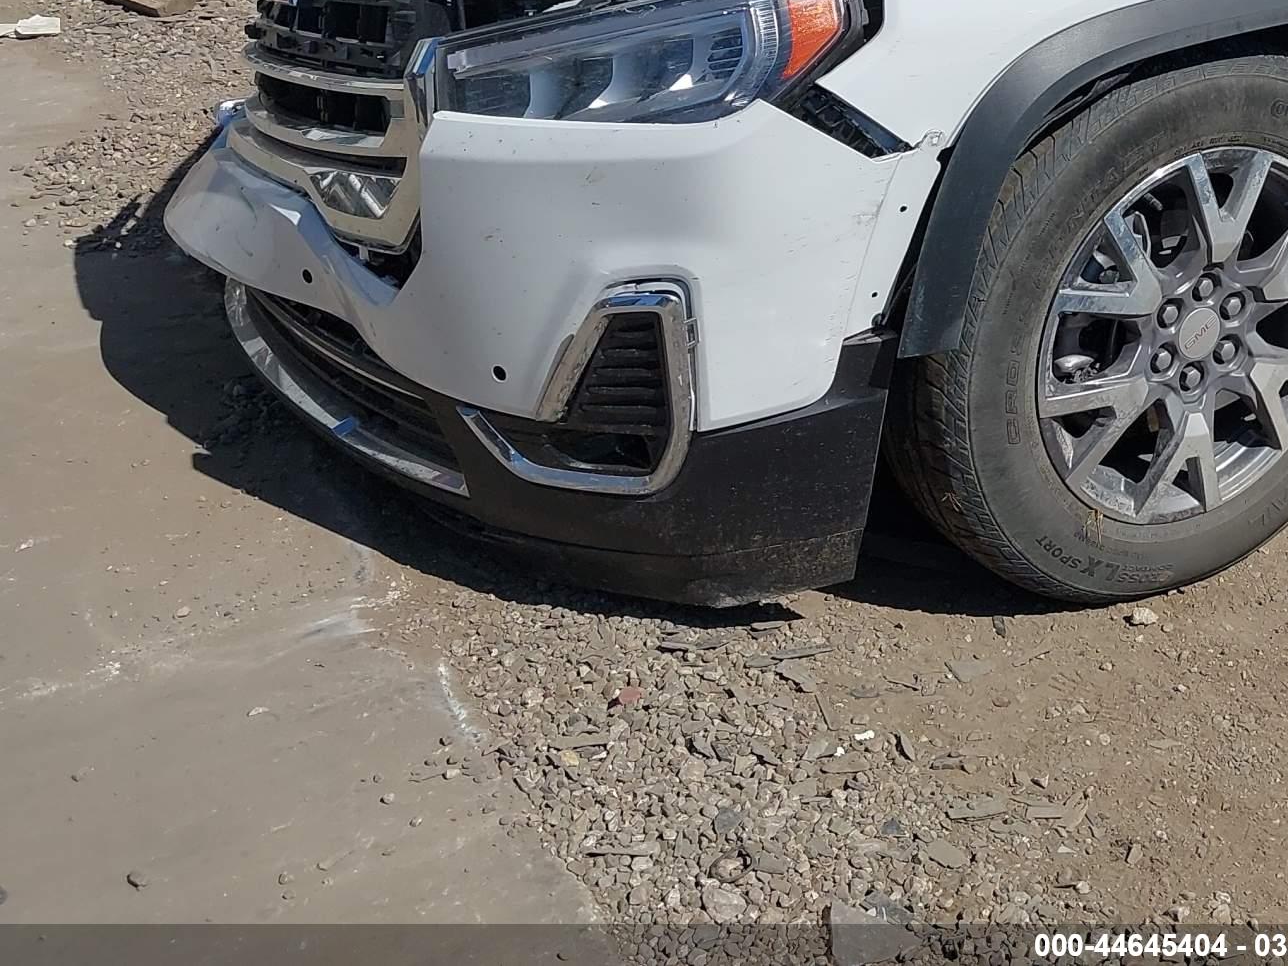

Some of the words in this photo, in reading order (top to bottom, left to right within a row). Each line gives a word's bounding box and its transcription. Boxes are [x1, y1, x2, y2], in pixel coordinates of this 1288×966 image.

[1184, 315, 1217, 350] GMC
[1035, 535, 1082, 569] SPORT
[1080, 555, 1121, 582] LX
